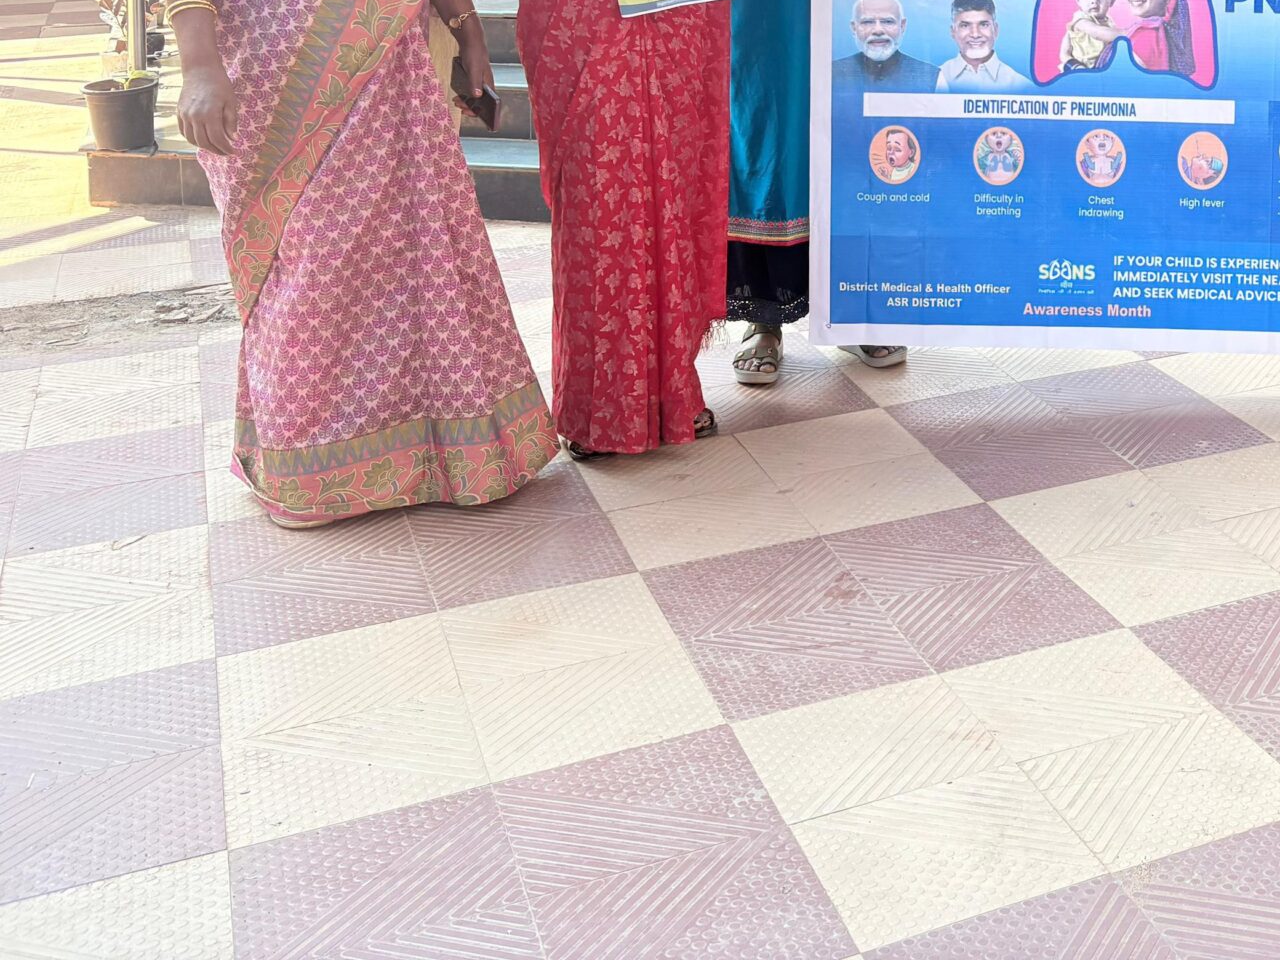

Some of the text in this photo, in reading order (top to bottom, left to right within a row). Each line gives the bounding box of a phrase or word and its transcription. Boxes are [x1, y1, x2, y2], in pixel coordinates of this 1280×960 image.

[963, 99, 1137, 117] IDENTIFICATION OF PNEUMONIA
[857, 192, 930, 204] Cough and cold
[974, 193, 1024, 206] Difficulty in
[1088, 196, 1115, 206] Chest
[1179, 197, 1225, 209] High fever
[976, 205, 1021, 218] breathing
[1078, 208, 1124, 220] indrawing
[1113, 255, 1125, 266] IF
[1127, 256, 1163, 267] YOUR
[1165, 257, 1203, 268] CHILD
[1206, 257, 1218, 268] IS
[1113, 271, 1199, 283] IMMEDIATELY
[1201, 273, 1232, 284] VISIT
[1235, 274, 1260, 285] THE
[839, 282, 1011, 294] District Medical & Health Officer
[1113, 287, 1141, 298] AND
[1143, 288, 1174, 299] SEEK
[1177, 288, 1233, 300] MEDICAL
[887, 297, 962, 308] ASR DISTRICT
[1023, 303, 1152, 318] Awareness Month
